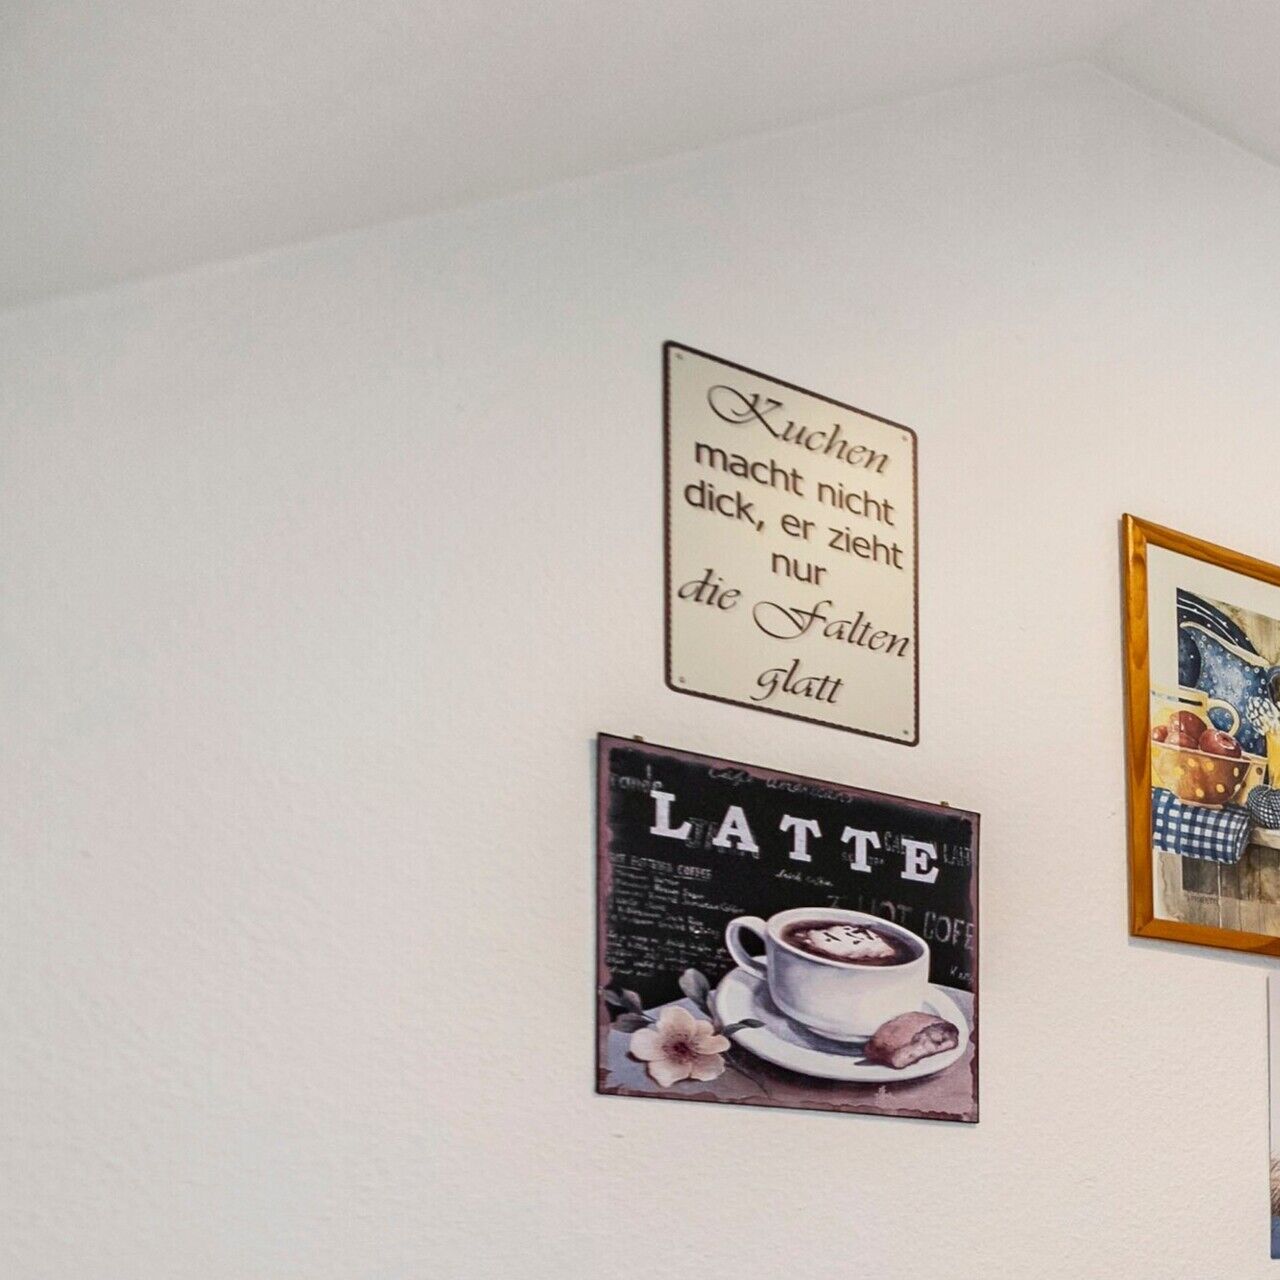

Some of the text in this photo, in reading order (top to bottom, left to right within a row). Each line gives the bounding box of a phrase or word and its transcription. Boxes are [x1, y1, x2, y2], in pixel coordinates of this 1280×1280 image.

[706, 384, 890, 475] Kuchen
[683, 479, 904, 571] dick, er zieht
[694, 440, 895, 527] macht nicht
[771, 552, 828, 586] nur
[678, 570, 910, 656] die Falten
[750, 660, 846, 704] glatt
[650, 789, 939, 884] LATTE
